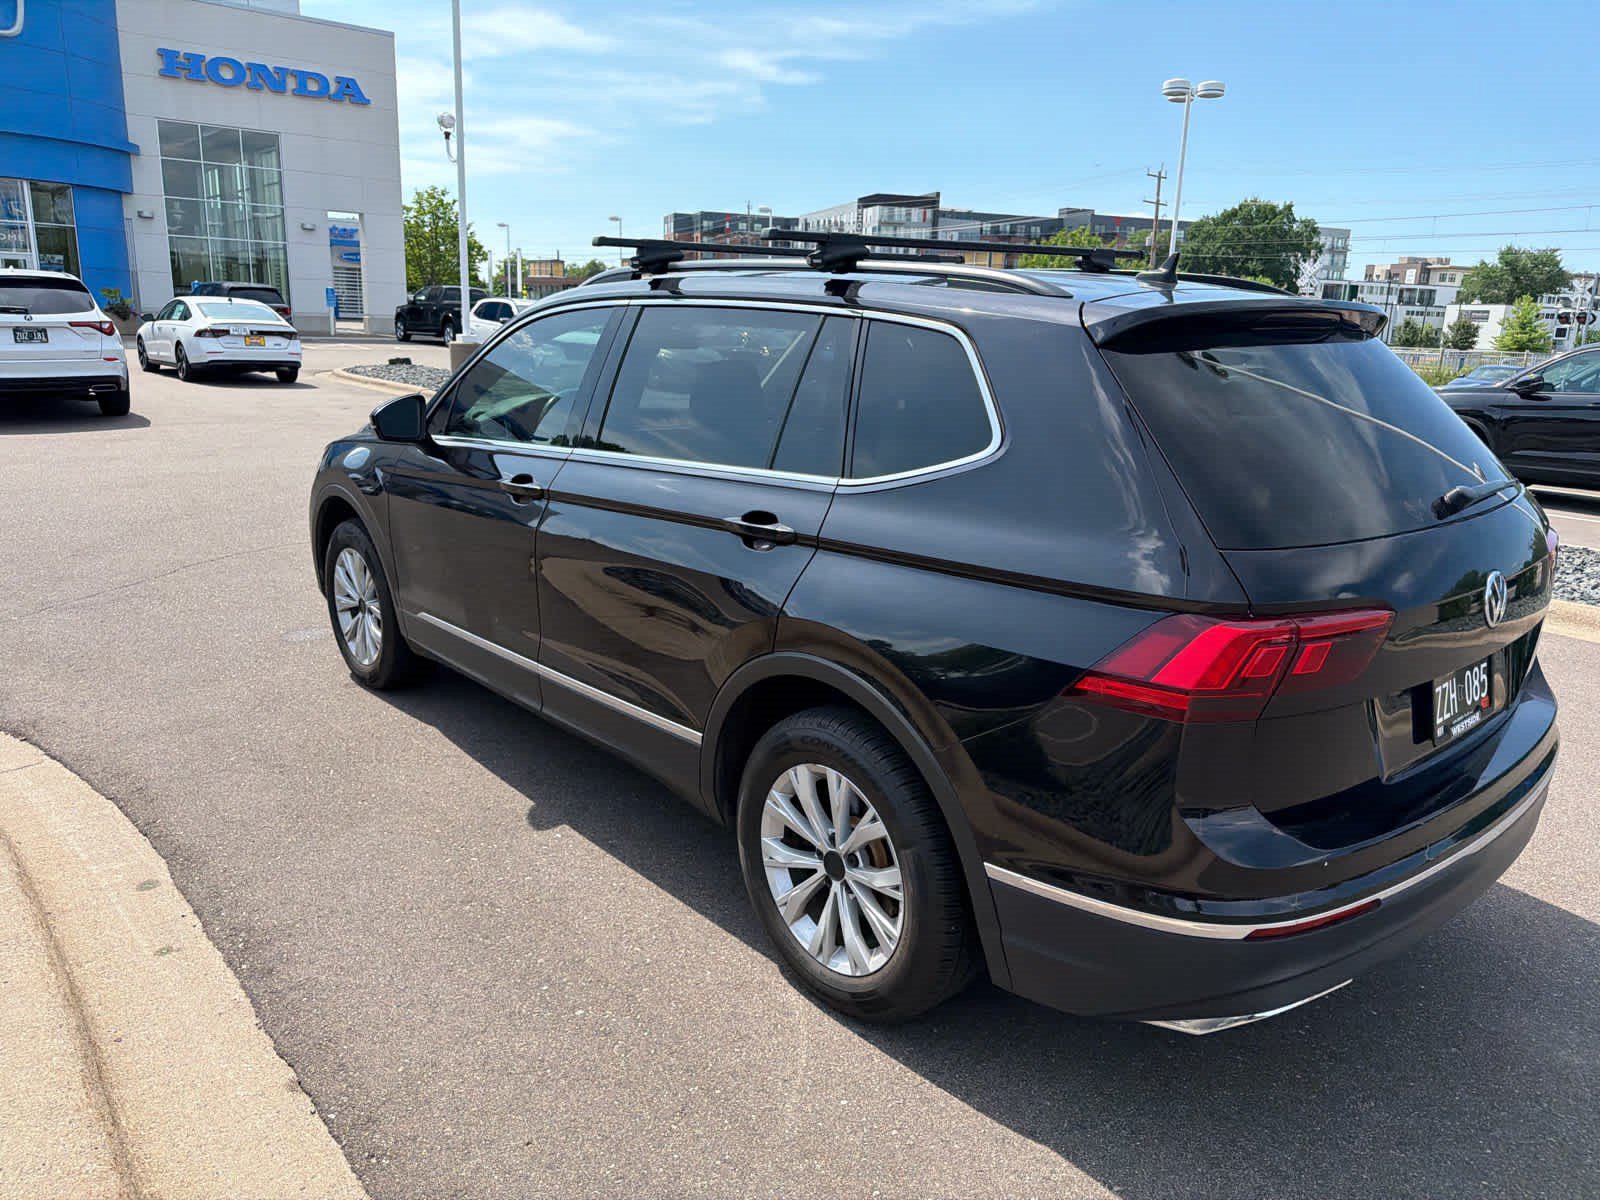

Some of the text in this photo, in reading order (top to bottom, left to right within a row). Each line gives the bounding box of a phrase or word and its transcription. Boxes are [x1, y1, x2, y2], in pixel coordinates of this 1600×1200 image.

[157, 48, 371, 105] HONDA
[1435, 662, 1488, 726] ZZH 085
